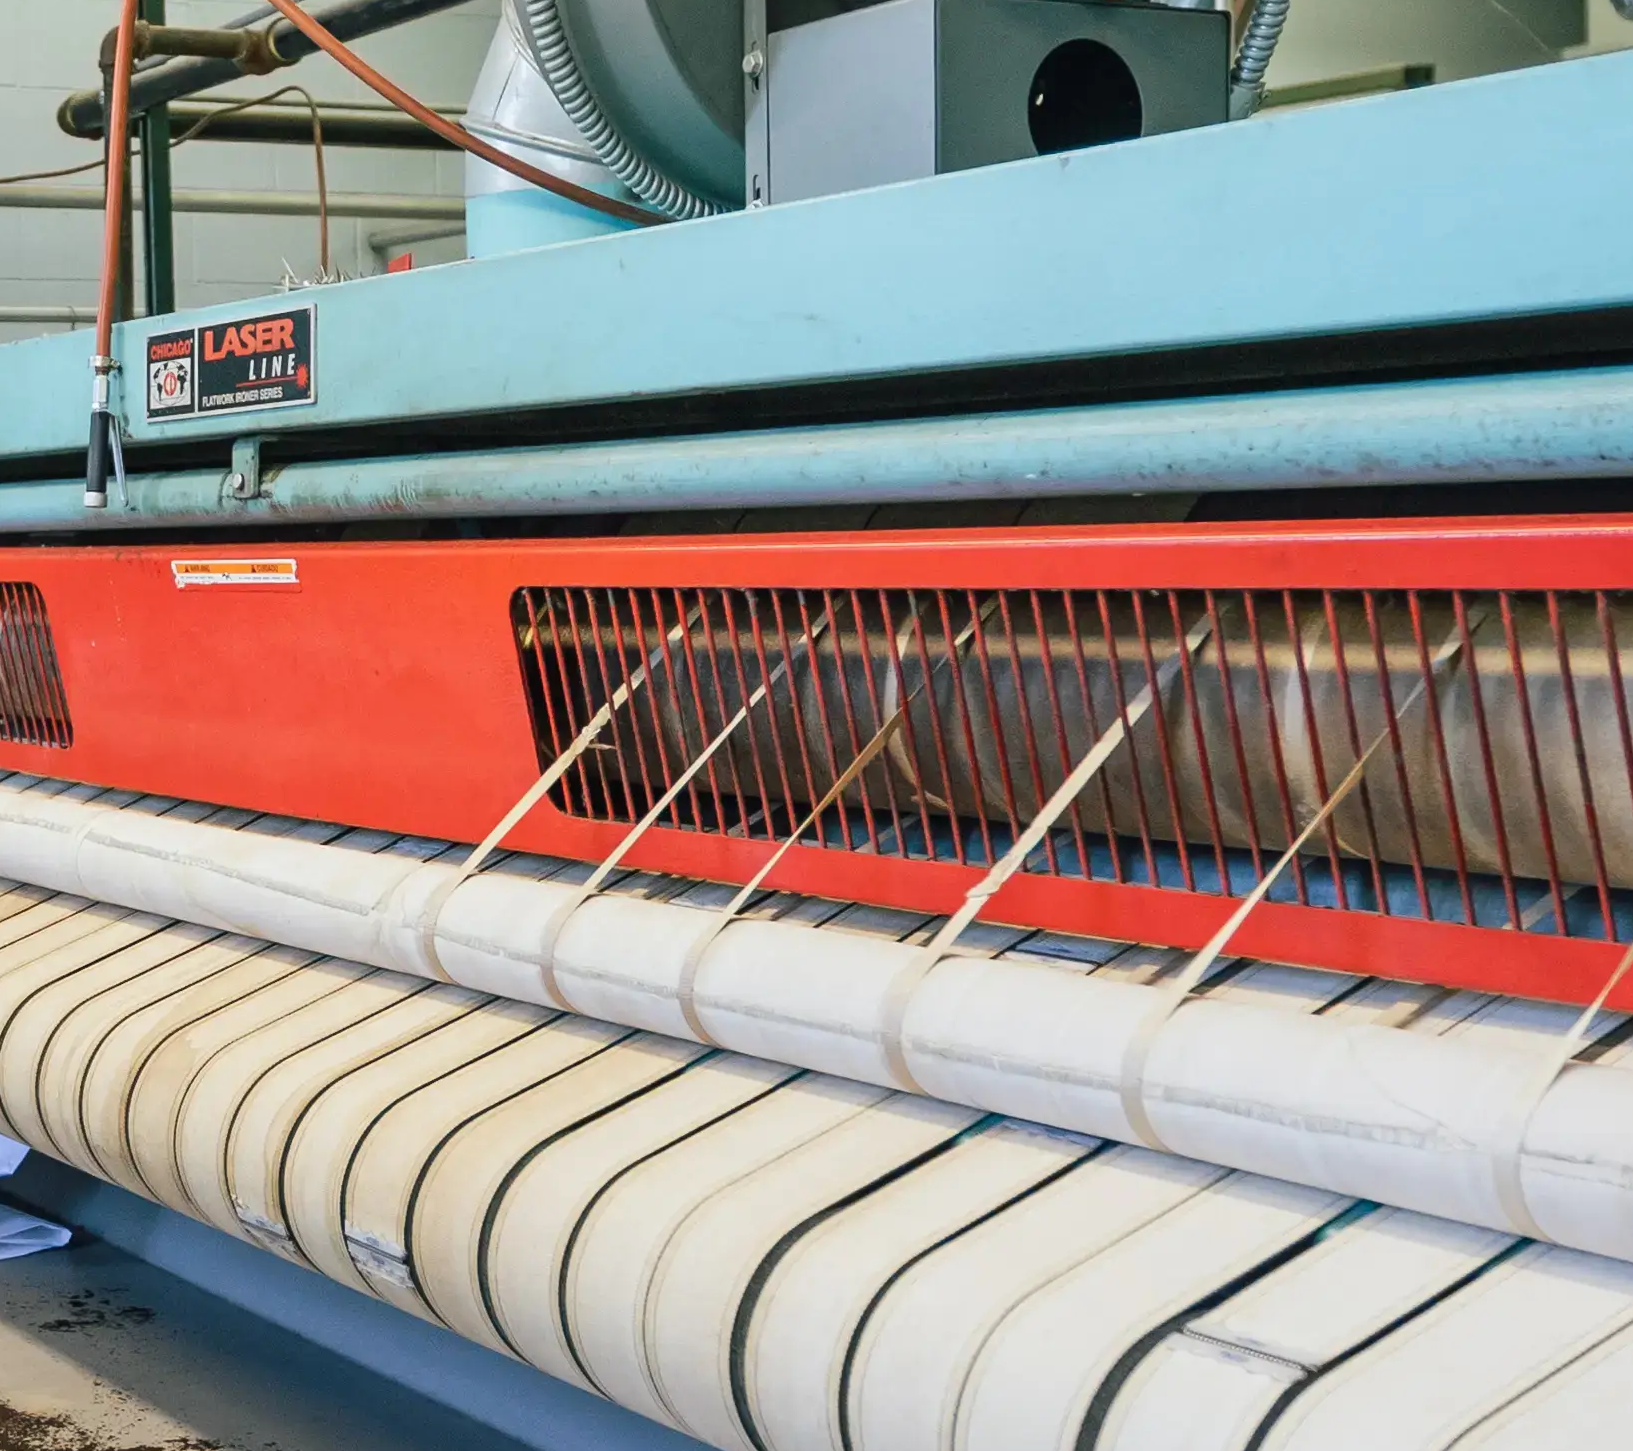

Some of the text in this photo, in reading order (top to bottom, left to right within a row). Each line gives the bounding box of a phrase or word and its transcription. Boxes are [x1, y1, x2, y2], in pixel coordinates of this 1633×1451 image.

[150, 339, 191, 361] CHICAGO
[203, 318, 295, 362] LASER
[248, 353, 296, 381] LINE
[202, 386, 283, 407] FLATWORK IRONER SERIES
